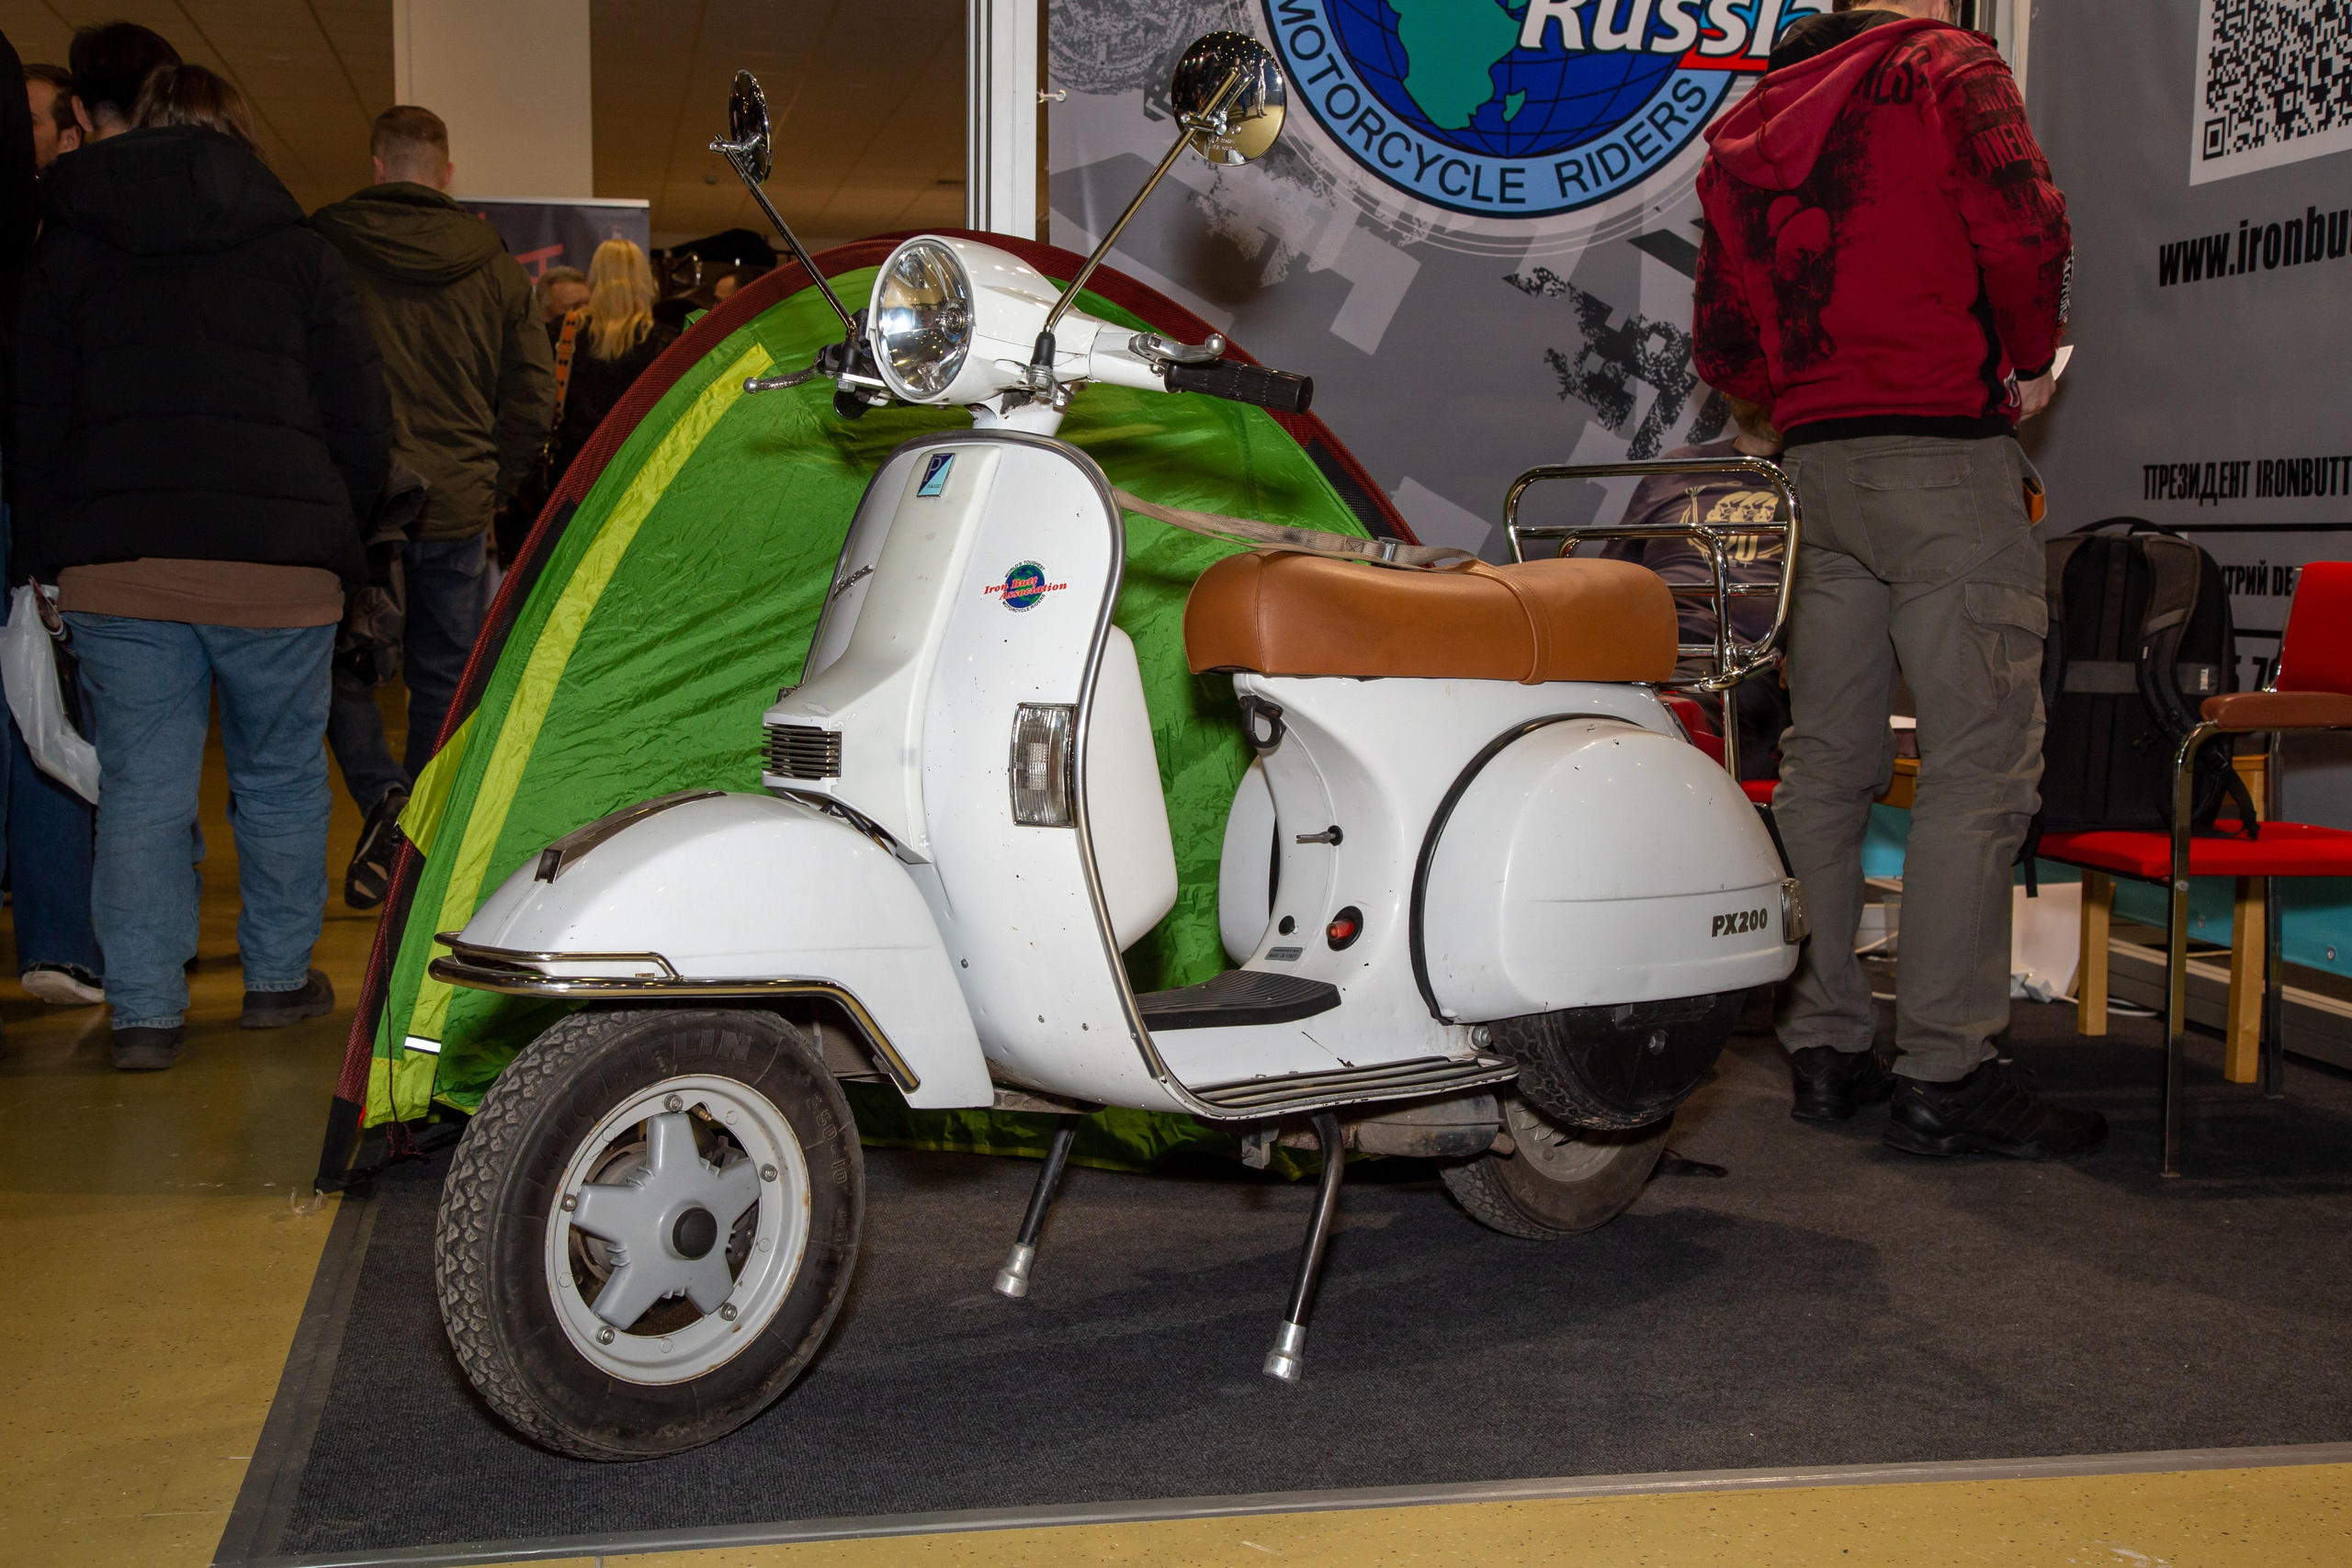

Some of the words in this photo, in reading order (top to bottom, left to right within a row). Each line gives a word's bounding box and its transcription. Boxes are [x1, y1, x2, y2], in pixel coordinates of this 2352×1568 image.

[1277, 0, 1526, 204] MOTORCYCLE
[1556, 76, 1708, 199] RIDERS
[2159, 205, 2352, 288] www.ironbu
[2143, 460, 2252, 507] ПРЕЗИДЕНТ
[2256, 456, 2352, 498] IRONBUTT
[1023, 559, 1046, 571] TOUGHEST
[2220, 558, 2268, 596] ТРИЙ
[2272, 566, 2296, 596] DE
[983, 582, 1009, 595] Iron
[1011, 575, 1038, 590] Butt
[998, 581, 1068, 601] Association
[1001, 600, 1030, 614] MOTORCYCLE
[1030, 593, 1046, 610] RIDERS
[1711, 908, 1769, 938] PX200
[526, 1029, 753, 1189] MICHELIN
